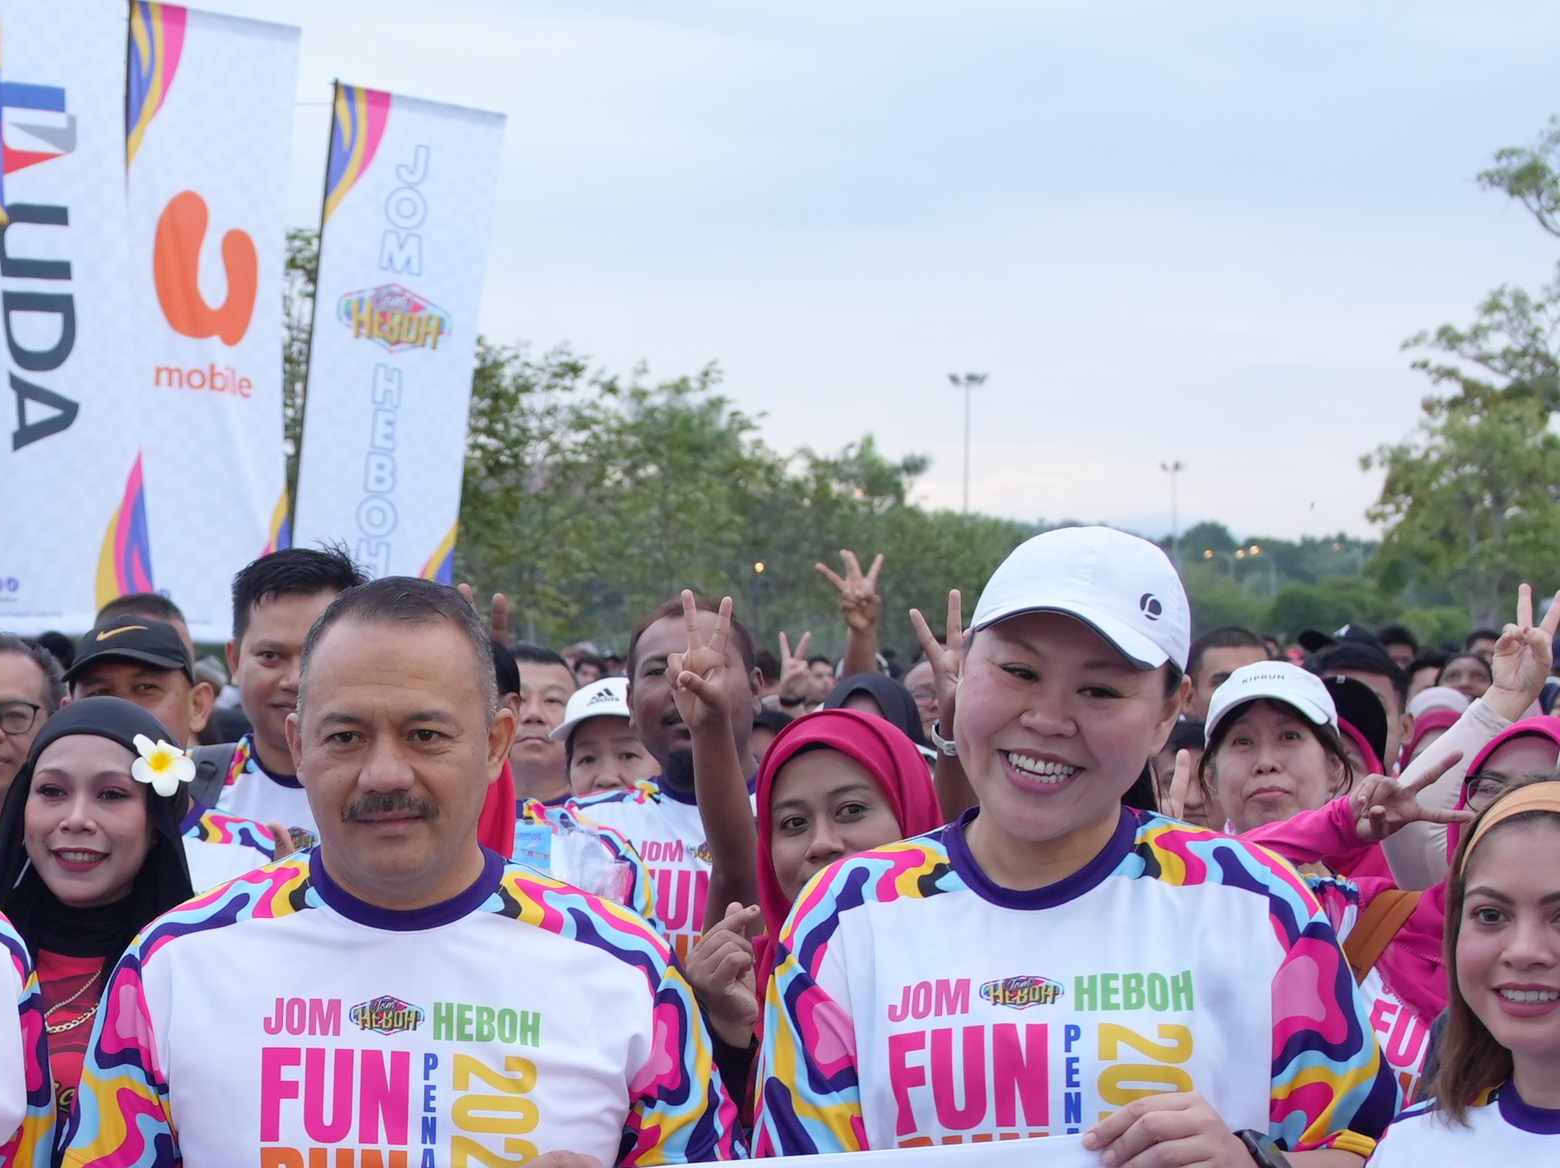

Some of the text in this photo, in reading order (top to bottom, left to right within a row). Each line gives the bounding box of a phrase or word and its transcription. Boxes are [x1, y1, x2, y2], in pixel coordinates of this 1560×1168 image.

[378, 144, 431, 276] JOM
[154, 363, 253, 398] mobile
[1242, 673, 1285, 684] KIPRUN
[263, 997, 342, 1036] JOM
[433, 1002, 541, 1048] HEBOH
[888, 978, 971, 1022] JOM
[1074, 970, 1194, 1012] HEBOH
[260, 1047, 411, 1146] FUN
[888, 1023, 1050, 1137] FUN
[1064, 1024, 1082, 1134] PEN
